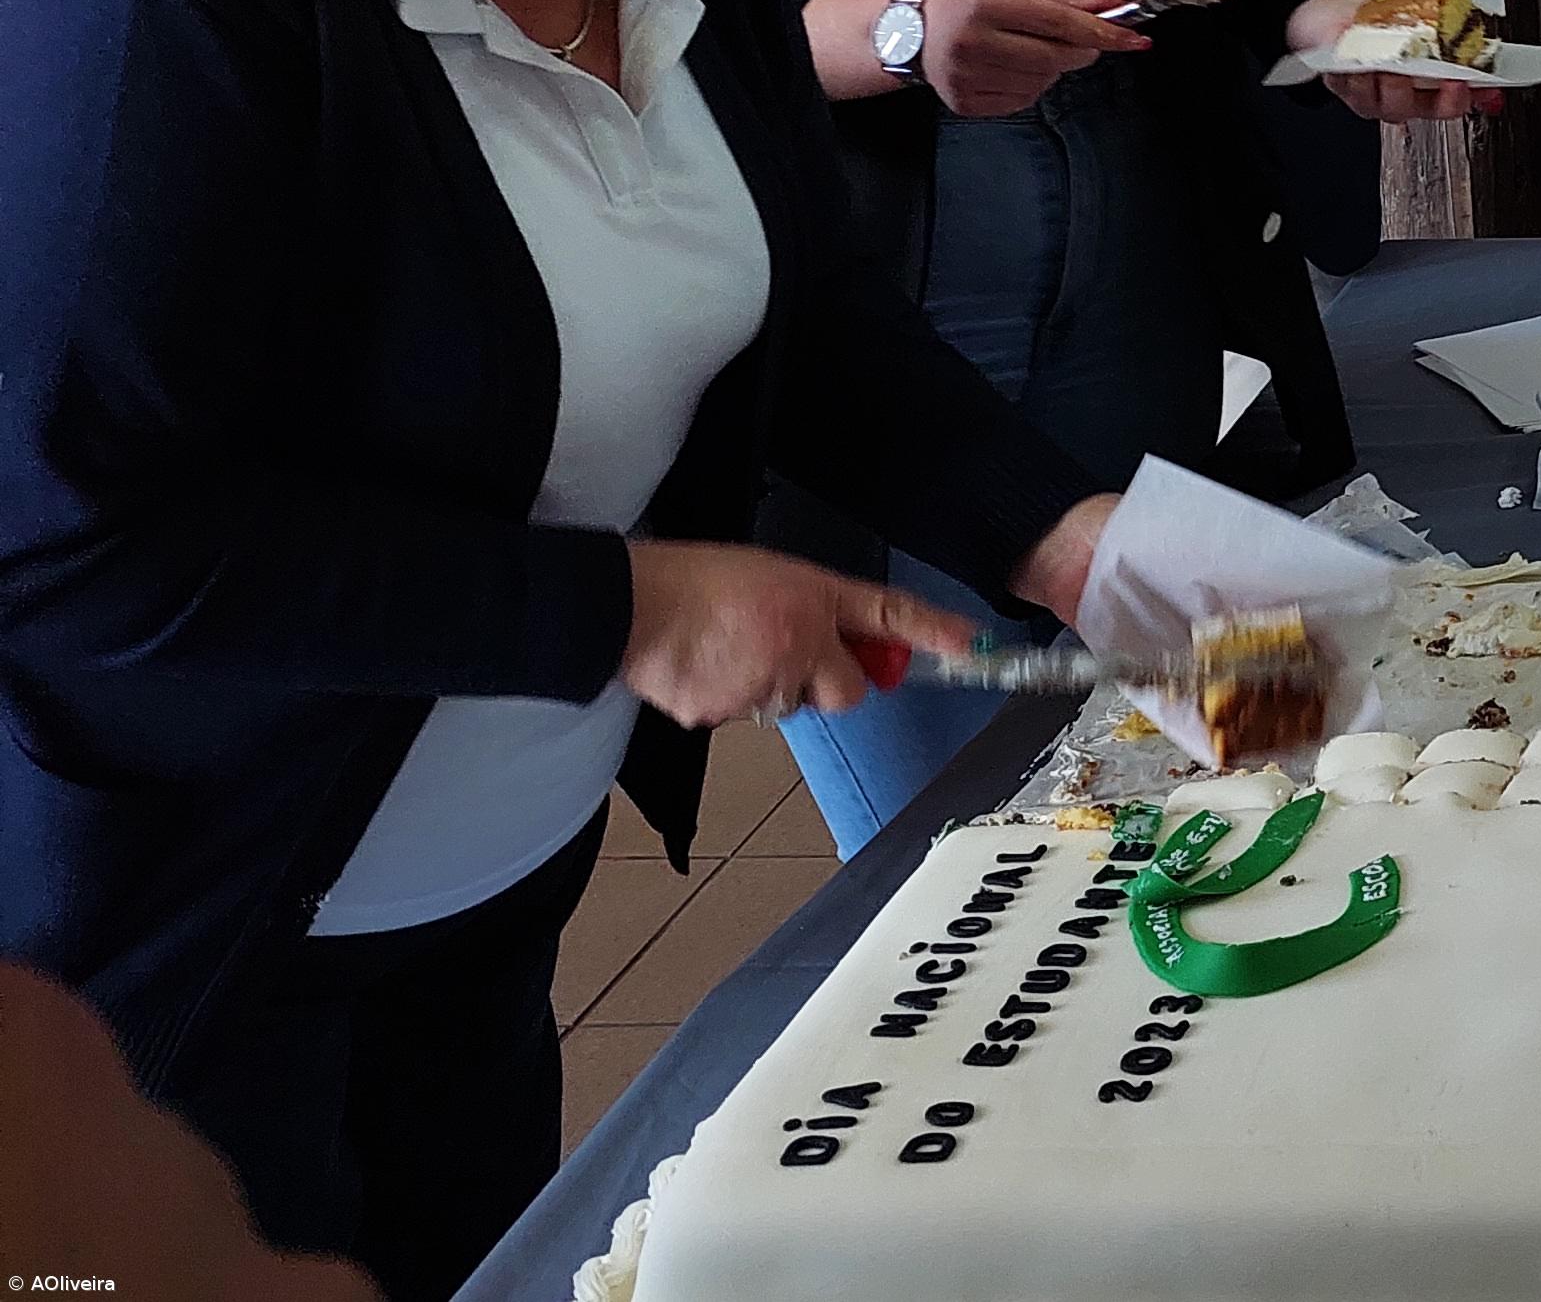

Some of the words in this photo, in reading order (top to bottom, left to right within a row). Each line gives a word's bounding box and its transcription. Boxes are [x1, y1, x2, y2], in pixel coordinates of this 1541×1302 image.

[898, 1100, 975, 1164] DO
[962, 840, 1158, 1068] ESTUDANTE
[1098, 994, 1204, 1104] 2023
